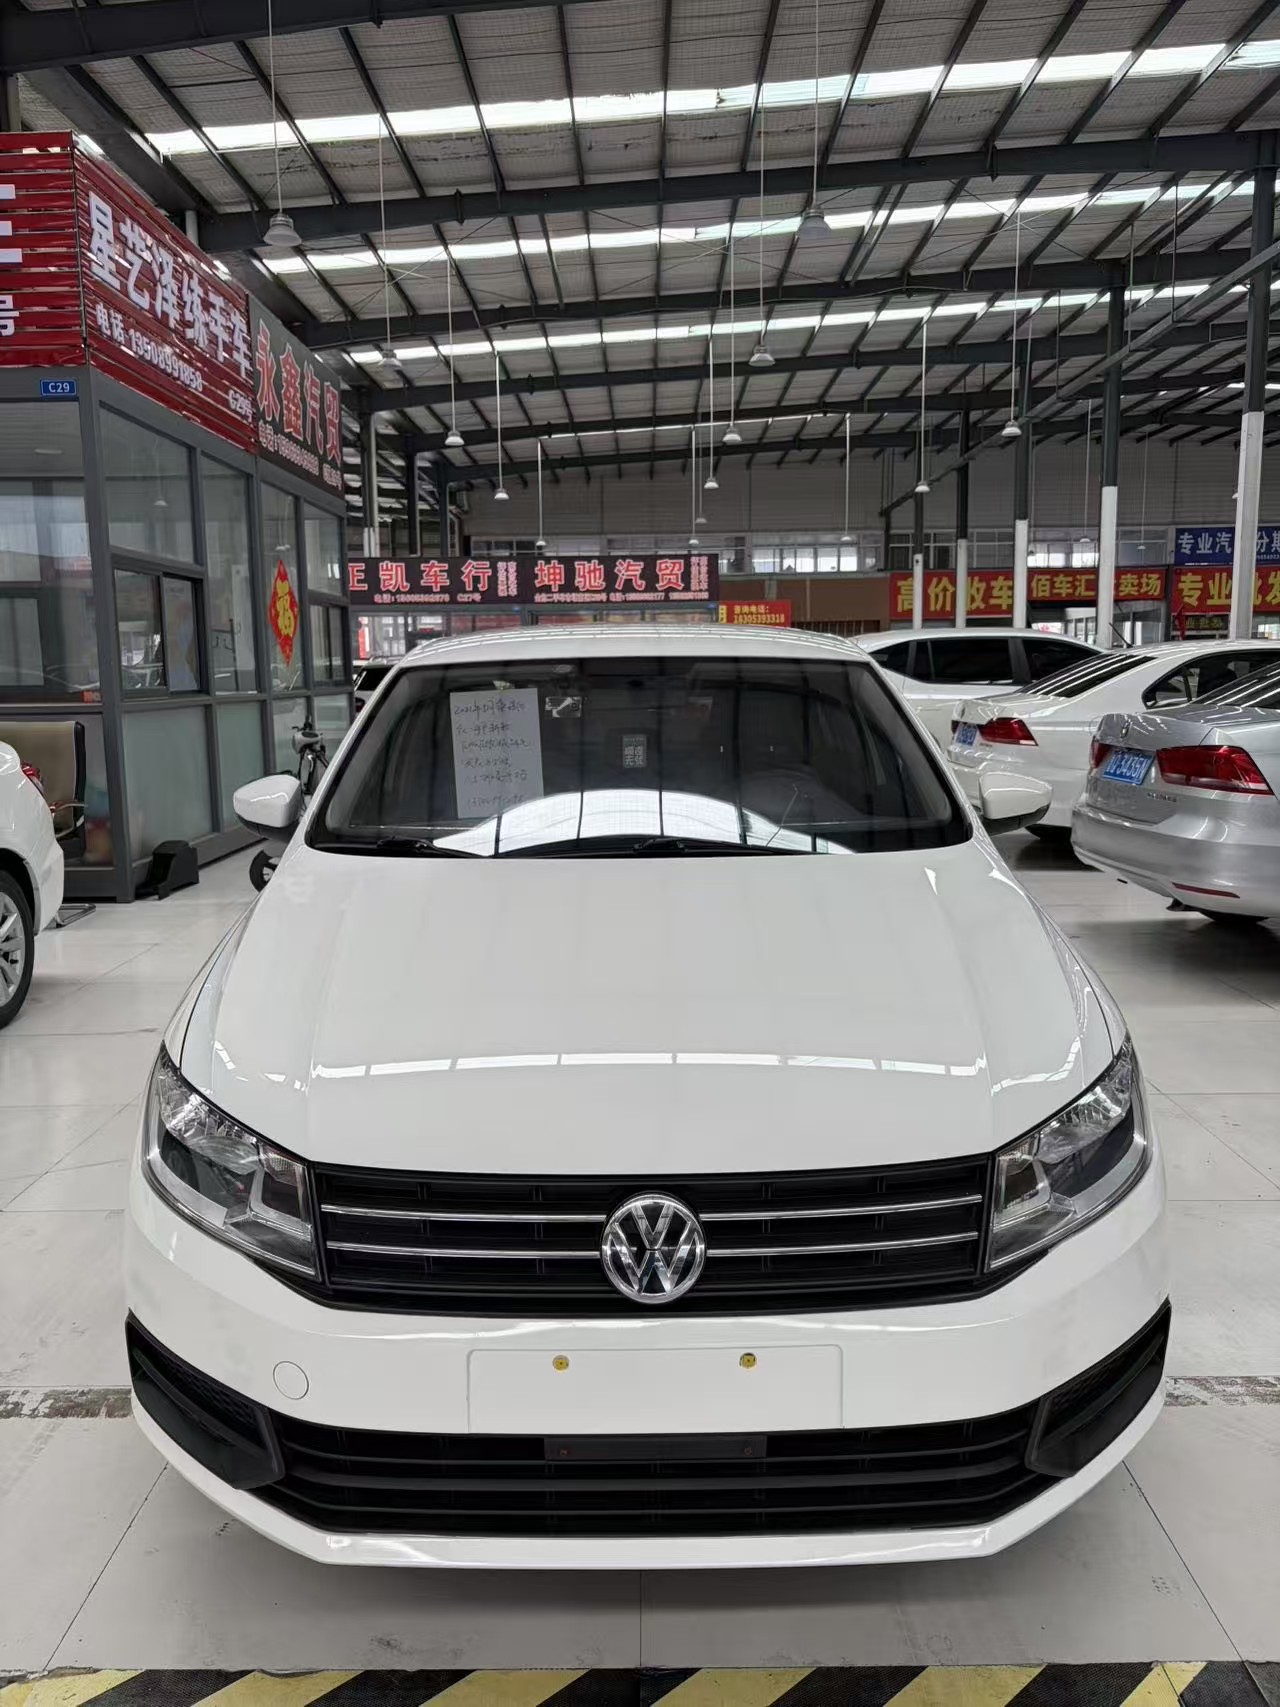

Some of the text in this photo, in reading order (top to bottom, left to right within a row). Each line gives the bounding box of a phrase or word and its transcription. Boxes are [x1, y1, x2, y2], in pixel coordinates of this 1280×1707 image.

[48, 381, 70, 393] C29
[256, 318, 342, 467] 永鑫汽贸
[534, 559, 684, 592] 坤驰汽贸
[1031, 573, 1161, 597] 佰车汇卖场
